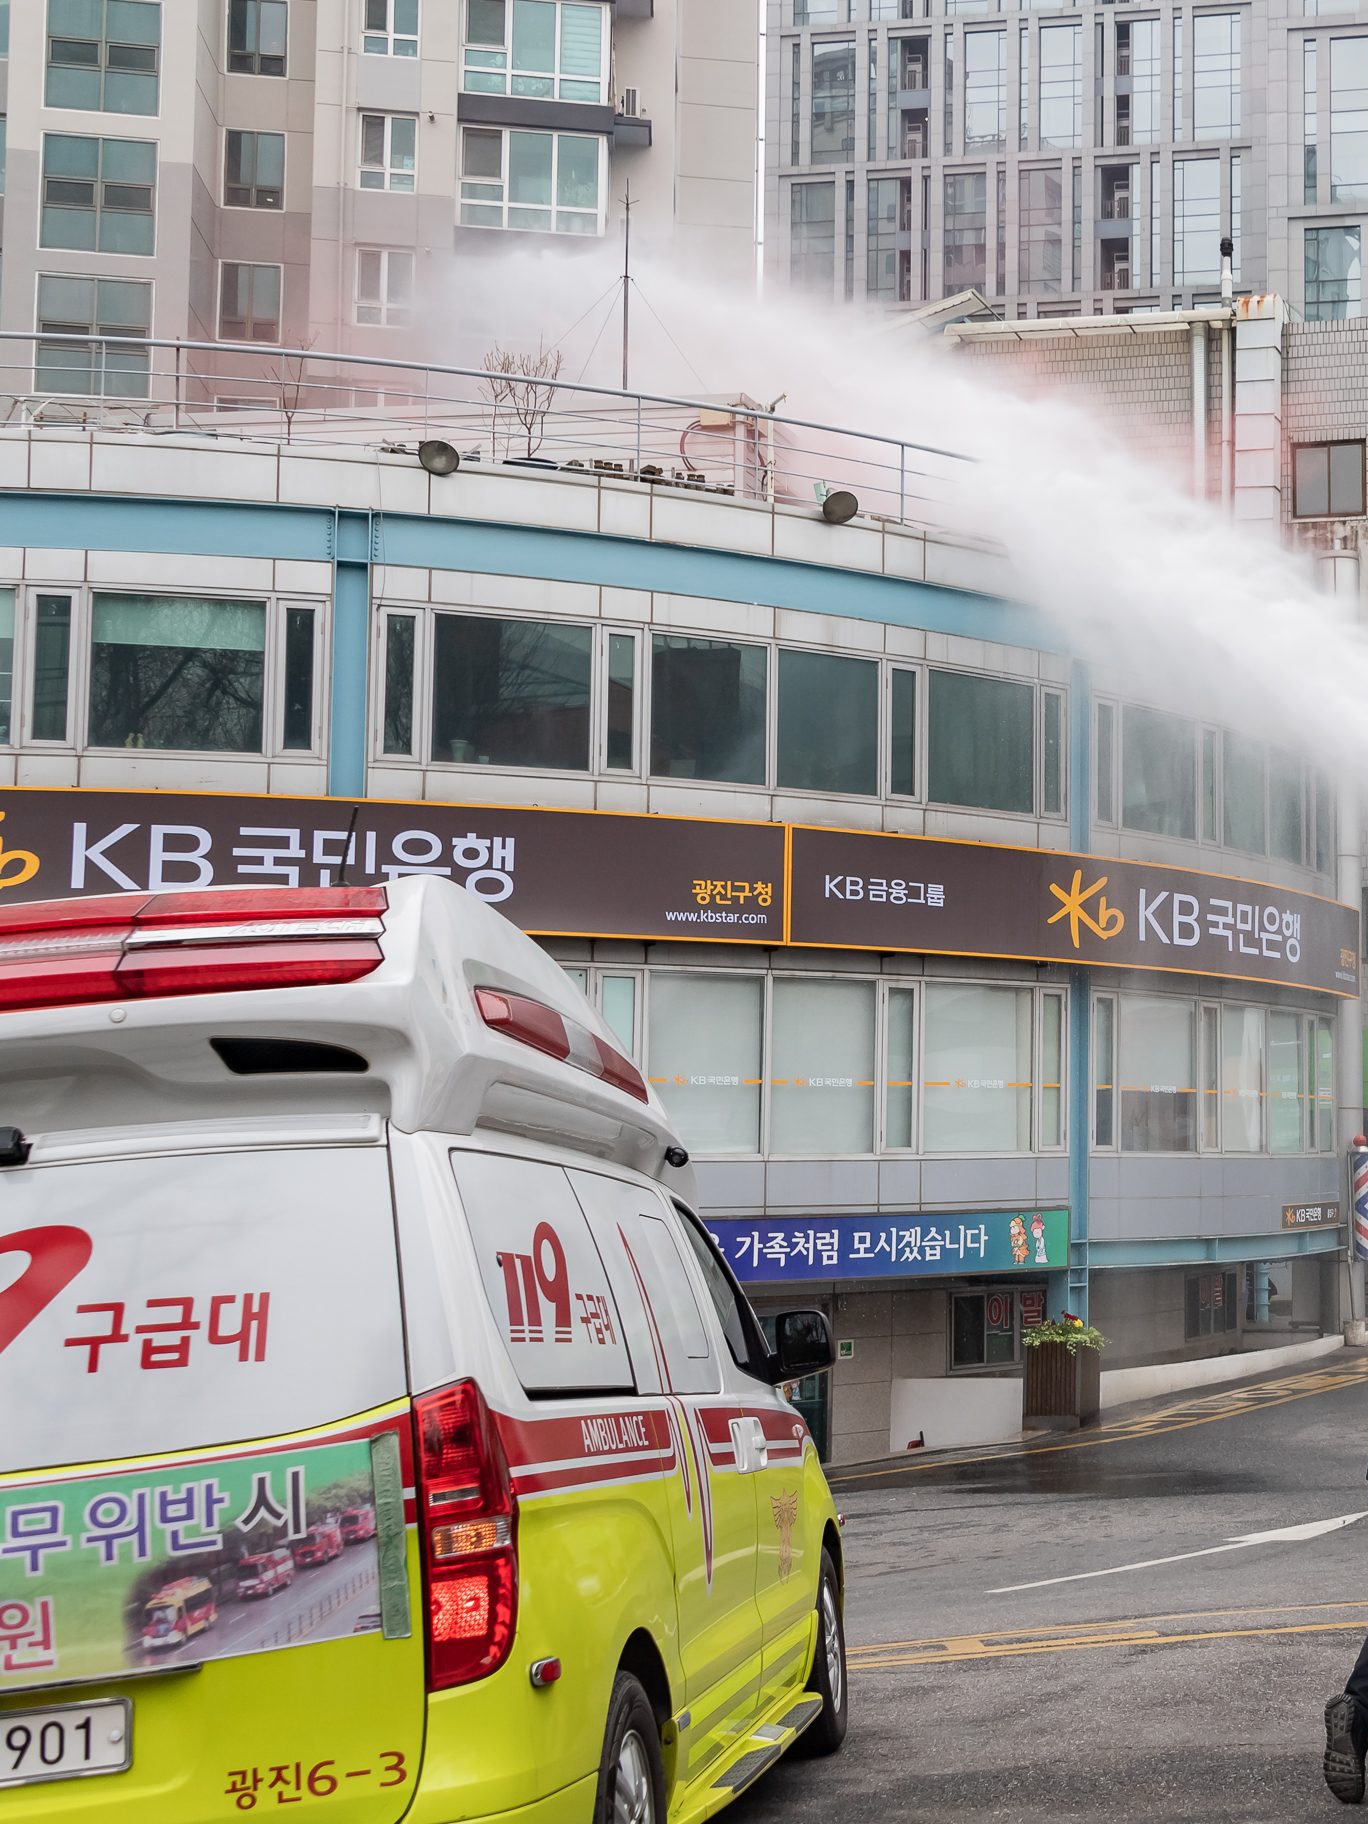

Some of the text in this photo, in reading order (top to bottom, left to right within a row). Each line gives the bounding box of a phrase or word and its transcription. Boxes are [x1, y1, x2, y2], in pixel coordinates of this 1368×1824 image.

[692, 879, 772, 907] 광진구청
[665, 909, 768, 925] www.kbstar.com
[735, 1228, 840, 1268] 가족처럼
[848, 1224, 989, 1262] 모시겠습니다
[496, 1221, 573, 1343] 119
[63, 1291, 271, 1374] 구급대
[580, 1411, 650, 1453] AMBULANCE
[224, 1750, 408, 1811] 광진6-3
